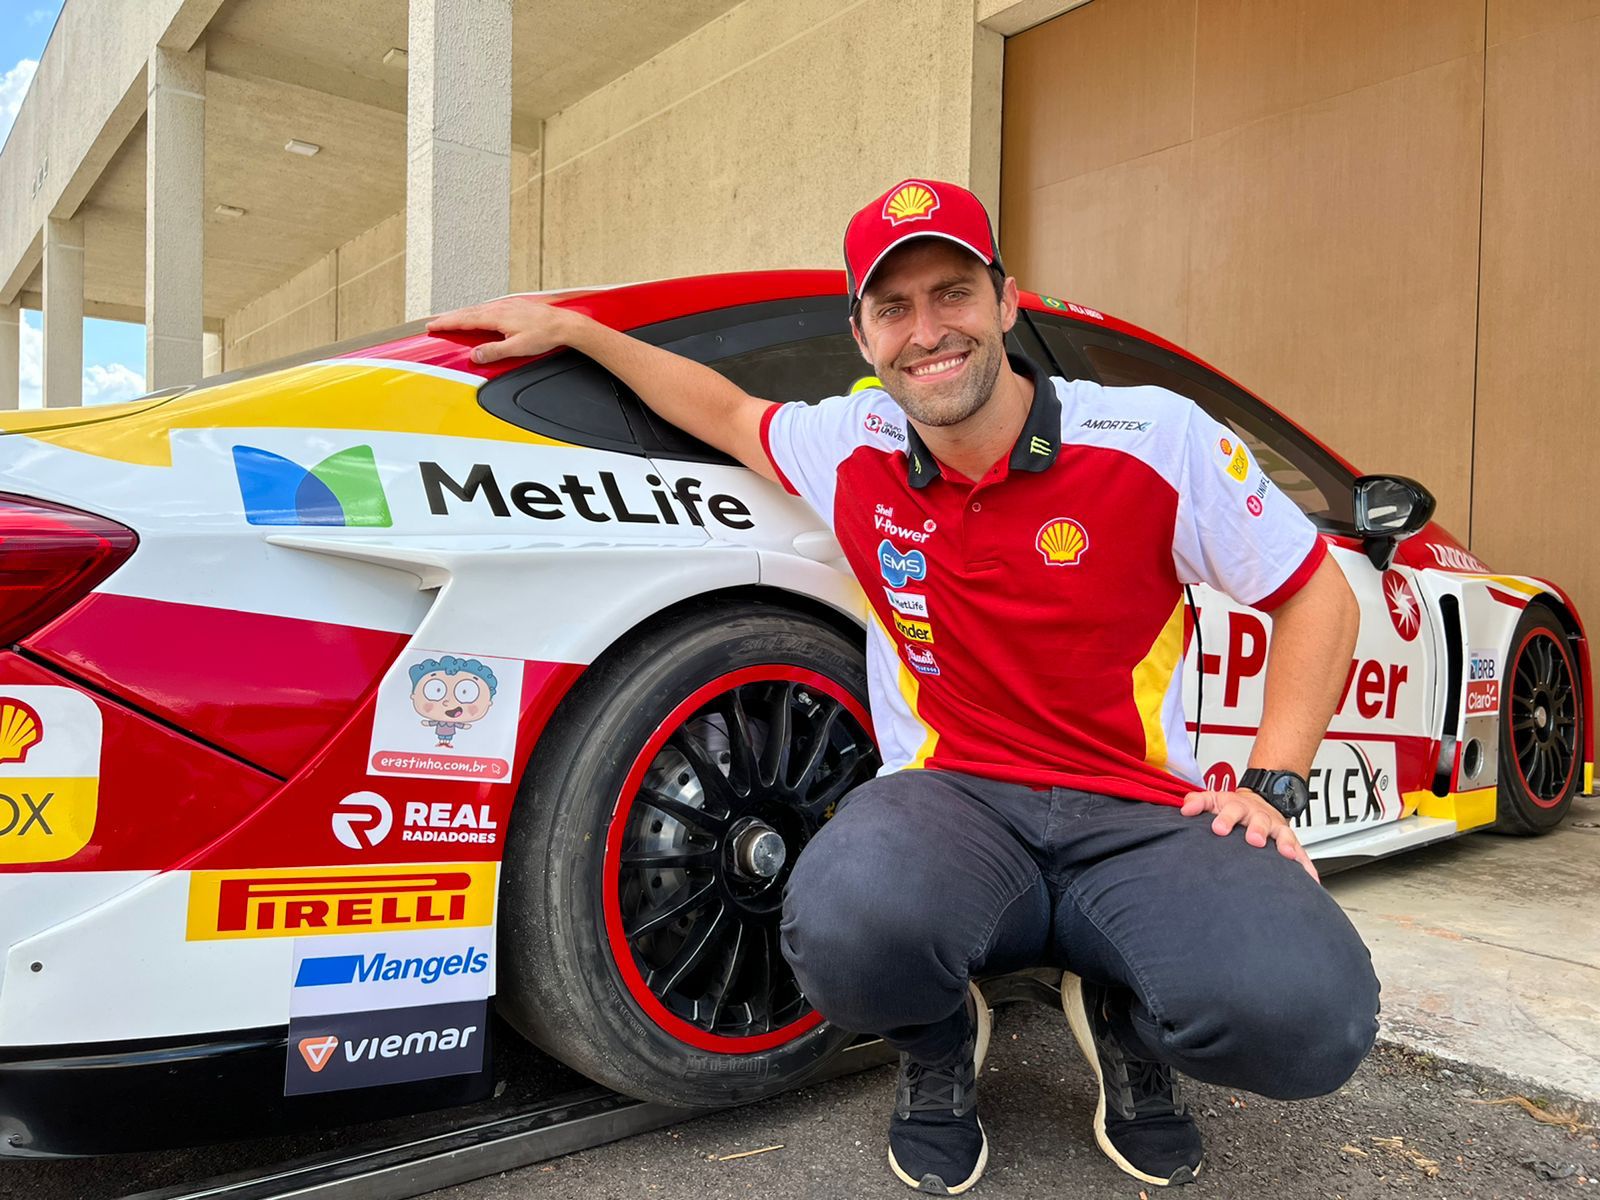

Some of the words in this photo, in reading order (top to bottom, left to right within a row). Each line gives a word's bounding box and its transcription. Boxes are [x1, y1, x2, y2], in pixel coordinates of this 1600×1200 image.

[1080, 418, 1150, 432] AMORTEX
[418, 461, 756, 530] MetLife
[1256, 475, 1270, 500] UNIFL
[875, 503, 894, 517] Shell
[874, 514, 930, 543] V-Power
[883, 553, 920, 573] EMS
[1478, 659, 1495, 679] BRB
[1468, 691, 1492, 710] Claro
[381, 756, 487, 774] erastinho.com.br
[1295, 768, 1383, 828] FLEX
[404, 801, 497, 829] REAL
[402, 830, 496, 844] RADIADORES
[217, 872, 471, 932] PIRELLI
[349, 946, 489, 984] Mangels
